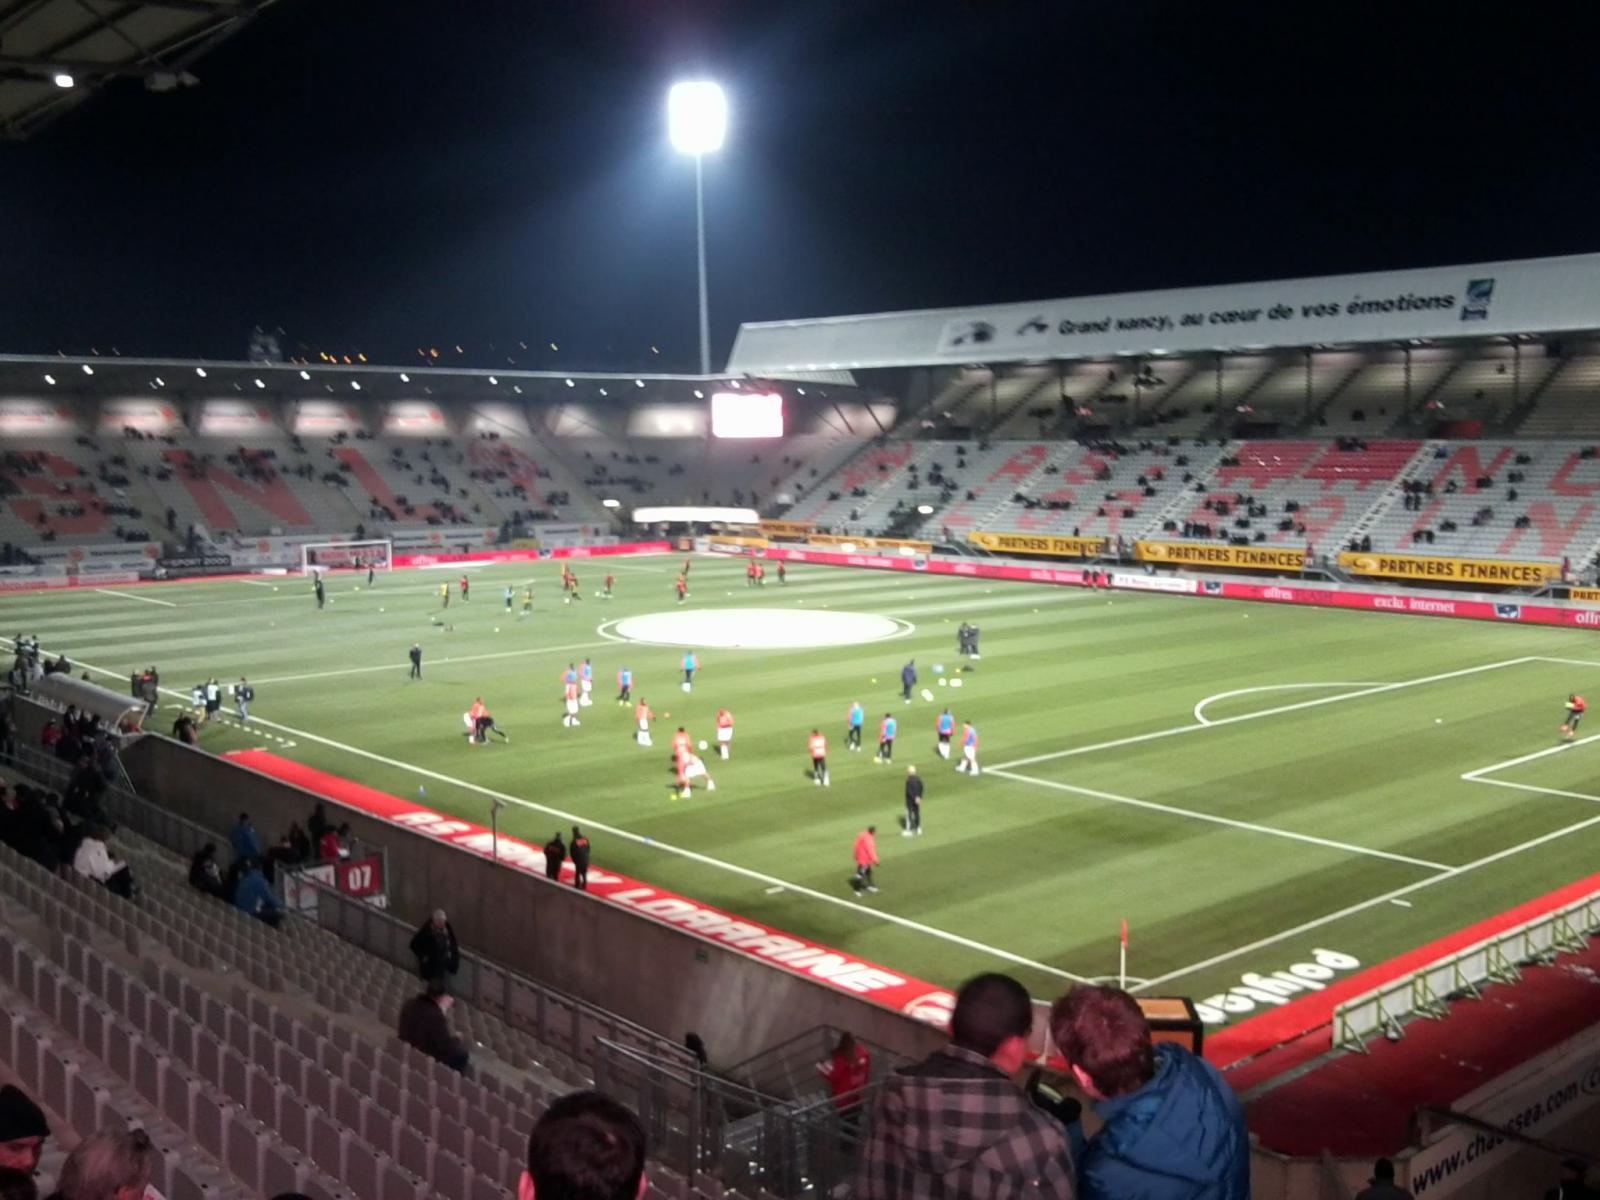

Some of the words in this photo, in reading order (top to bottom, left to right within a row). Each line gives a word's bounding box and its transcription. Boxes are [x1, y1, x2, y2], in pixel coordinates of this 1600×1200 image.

[1059, 316, 1111, 335] Grand
[1179, 312, 1204, 327] au
[1267, 303, 1294, 320] de
[1301, 302, 1341, 318] vos
[1346, 293, 1455, 315] émotions
[999, 536, 1048, 551] PARTNERS
[1053, 539, 1105, 555] FINANCE
[1167, 546, 1230, 562] PARTNERS
[1235, 550, 1304, 567] FINANCES
[1379, 558, 1454, 576] PARTNERS
[1460, 563, 1542, 582] FINANCES
[348, 866, 371, 890] 07
[607, 888, 907, 992] LORRAINE
